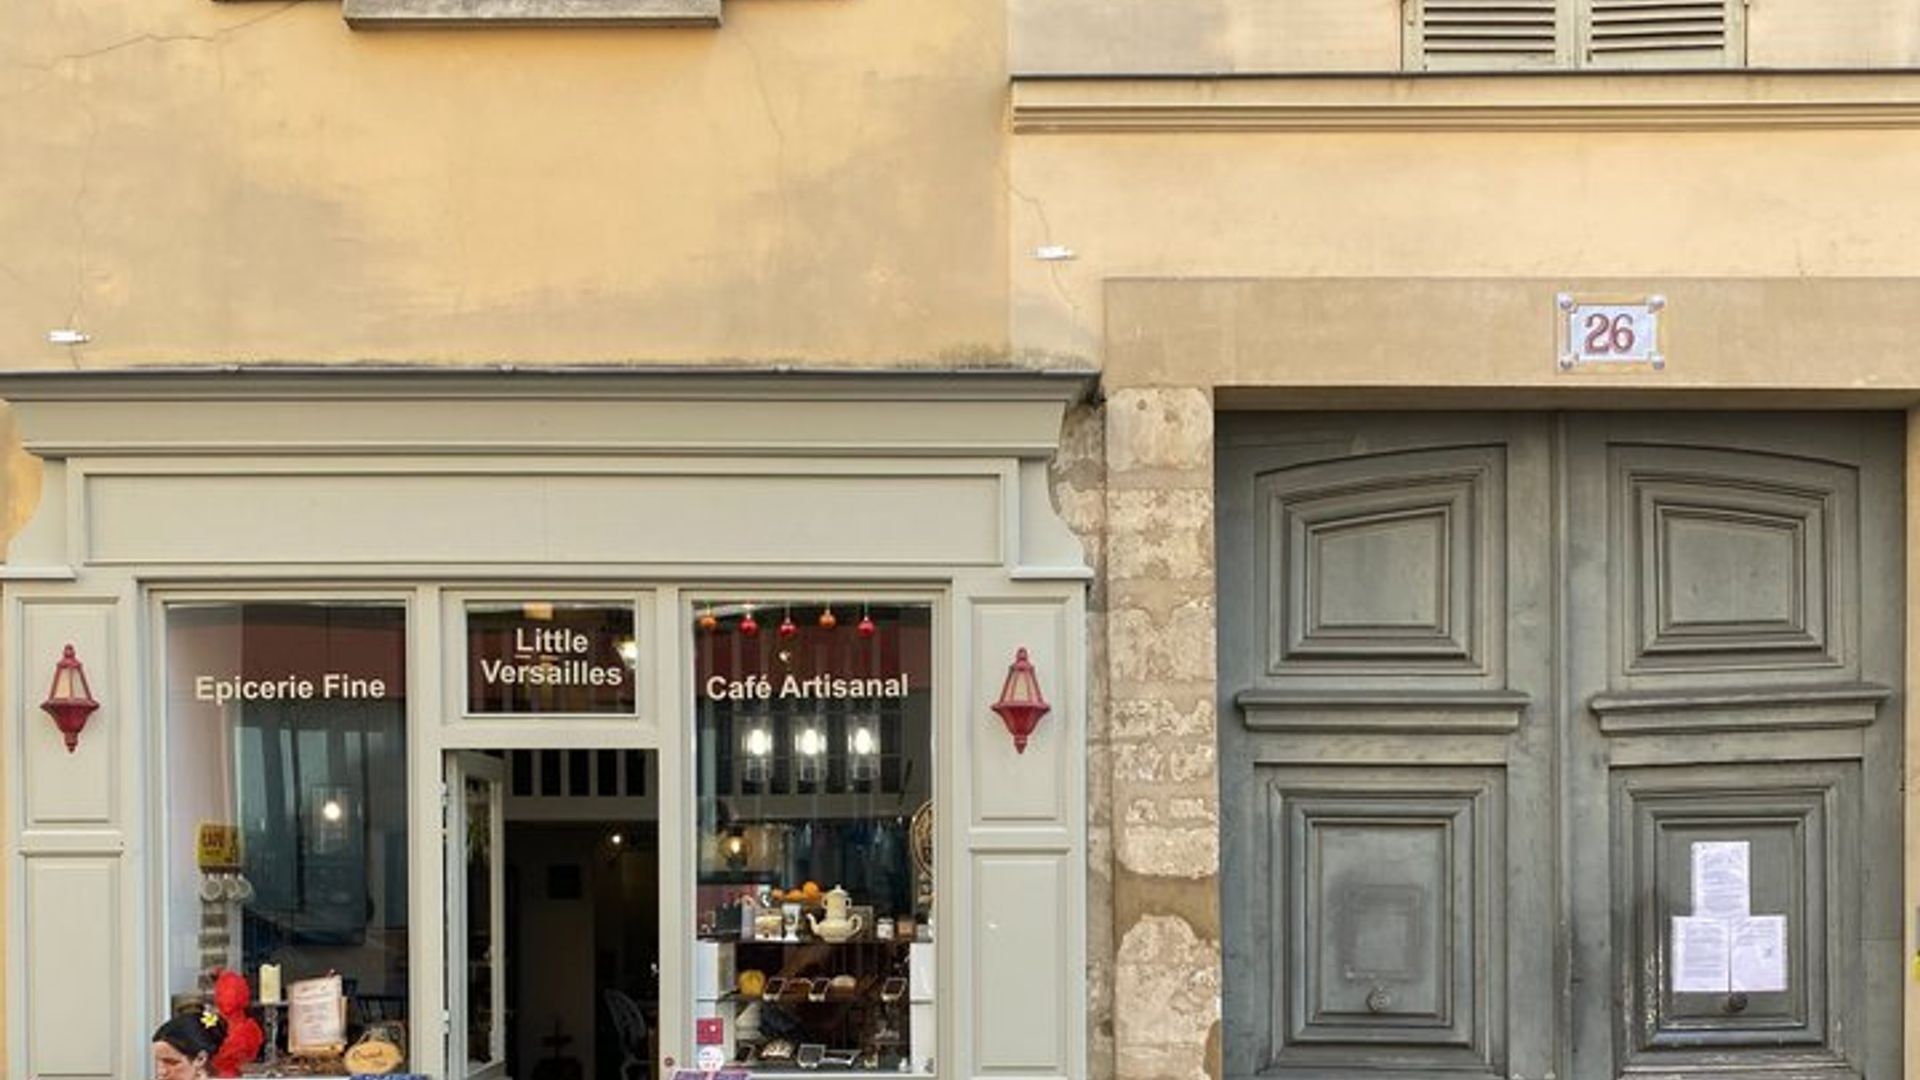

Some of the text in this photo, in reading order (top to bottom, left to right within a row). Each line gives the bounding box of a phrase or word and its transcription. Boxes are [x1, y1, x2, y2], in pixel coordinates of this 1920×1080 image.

[1585, 313, 1635, 355] 26
[515, 629, 589, 652] Little
[481, 661, 622, 686] Versailles
[195, 675, 386, 706] Epicerie Fine
[706, 674, 908, 700] Café Artisanal
